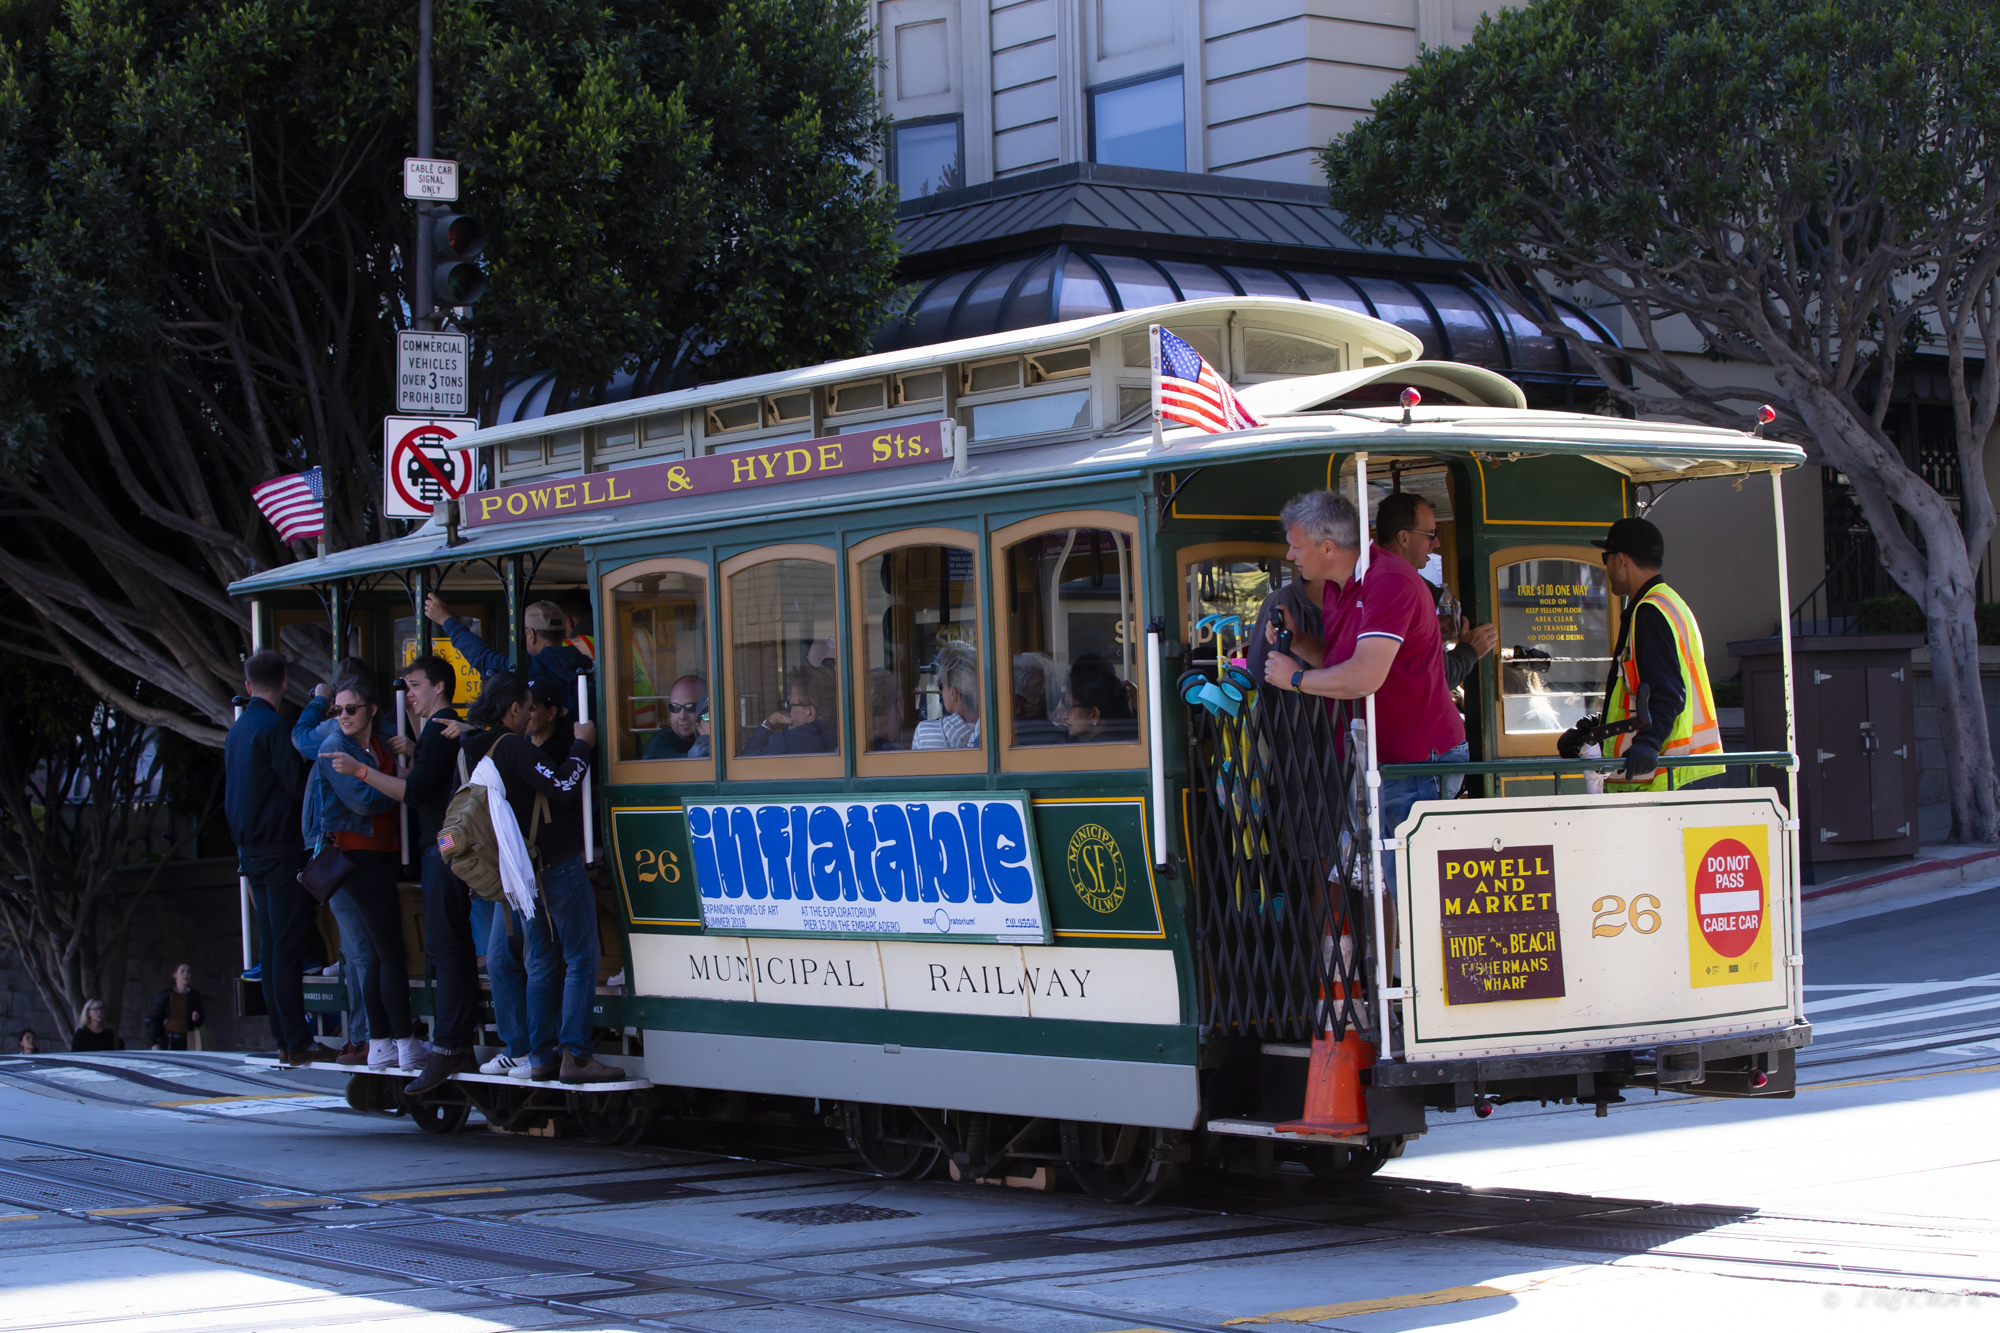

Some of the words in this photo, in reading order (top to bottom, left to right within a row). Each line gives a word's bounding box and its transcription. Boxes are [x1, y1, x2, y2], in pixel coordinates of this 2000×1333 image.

[410, 164, 434, 174] CABLE
[438, 165, 452, 175] CAR
[418, 174, 444, 184] SIGNAL
[421, 185, 441, 194] ONLY
[403, 340, 463, 353] COMMERCIAL
[408, 357, 457, 370] VEHICLES
[402, 374, 426, 386] OVER
[428, 372, 437, 390] 3
[440, 375, 463, 388] TONS
[402, 391, 463, 405] PROHIBITED
[479, 477, 632, 520] POWELL
[667, 465, 694, 492] &
[731, 442, 844, 483] HYDE
[872, 432, 930, 464] Sts.
[1517, 585, 1535, 596] FARE
[1537, 584, 1554, 596] $7.00
[1555, 585, 1571, 596] ONE
[1572, 584, 1588, 596] WAY
[687, 802, 1033, 904] inflatable
[1069, 826, 1120, 864] MUNICIPAL
[634, 848, 681, 883] 26
[1446, 857, 1549, 880] POWELL
[1707, 856, 1725, 872] DO
[1727, 855, 1750, 871] NOT
[1475, 878, 1525, 894] AND
[1715, 872, 1744, 889] PASS
[1075, 880, 1124, 911] RAILWAY
[1445, 892, 1552, 915] MARKET
[703, 904, 736, 915] EXPANDING
[736, 904, 759, 915] WORKS
[759, 905, 766, 915] OF
[768, 905, 779, 916] ART
[801, 906, 809, 917] AT
[809, 906, 822, 917] THE
[823, 906, 877, 918] EXPLORATORIUM
[1592, 893, 1662, 938] 26
[705, 916, 730, 928] SUMMER
[731, 917, 747, 928] 2018
[803, 919, 818, 930] PIER
[820, 920, 827, 930] 15
[827, 920, 837, 930] ON
[838, 920, 851, 931] THE
[852, 921, 901, 932] EMBARCADERO
[1703, 916, 1736, 932] CABLE
[1738, 914, 1758, 930] CAR
[1450, 935, 1487, 958] HYDE
[1490, 936, 1508, 955] AND
[1510, 931, 1556, 954] BEACH
[1461, 957, 1548, 977] FISHERMANS
[688, 954, 865, 987] MUNICIPAL
[927, 963, 1091, 998] RAILWAY
[1484, 975, 1528, 991] WHARF
[592, 1005, 604, 1013] NLY
